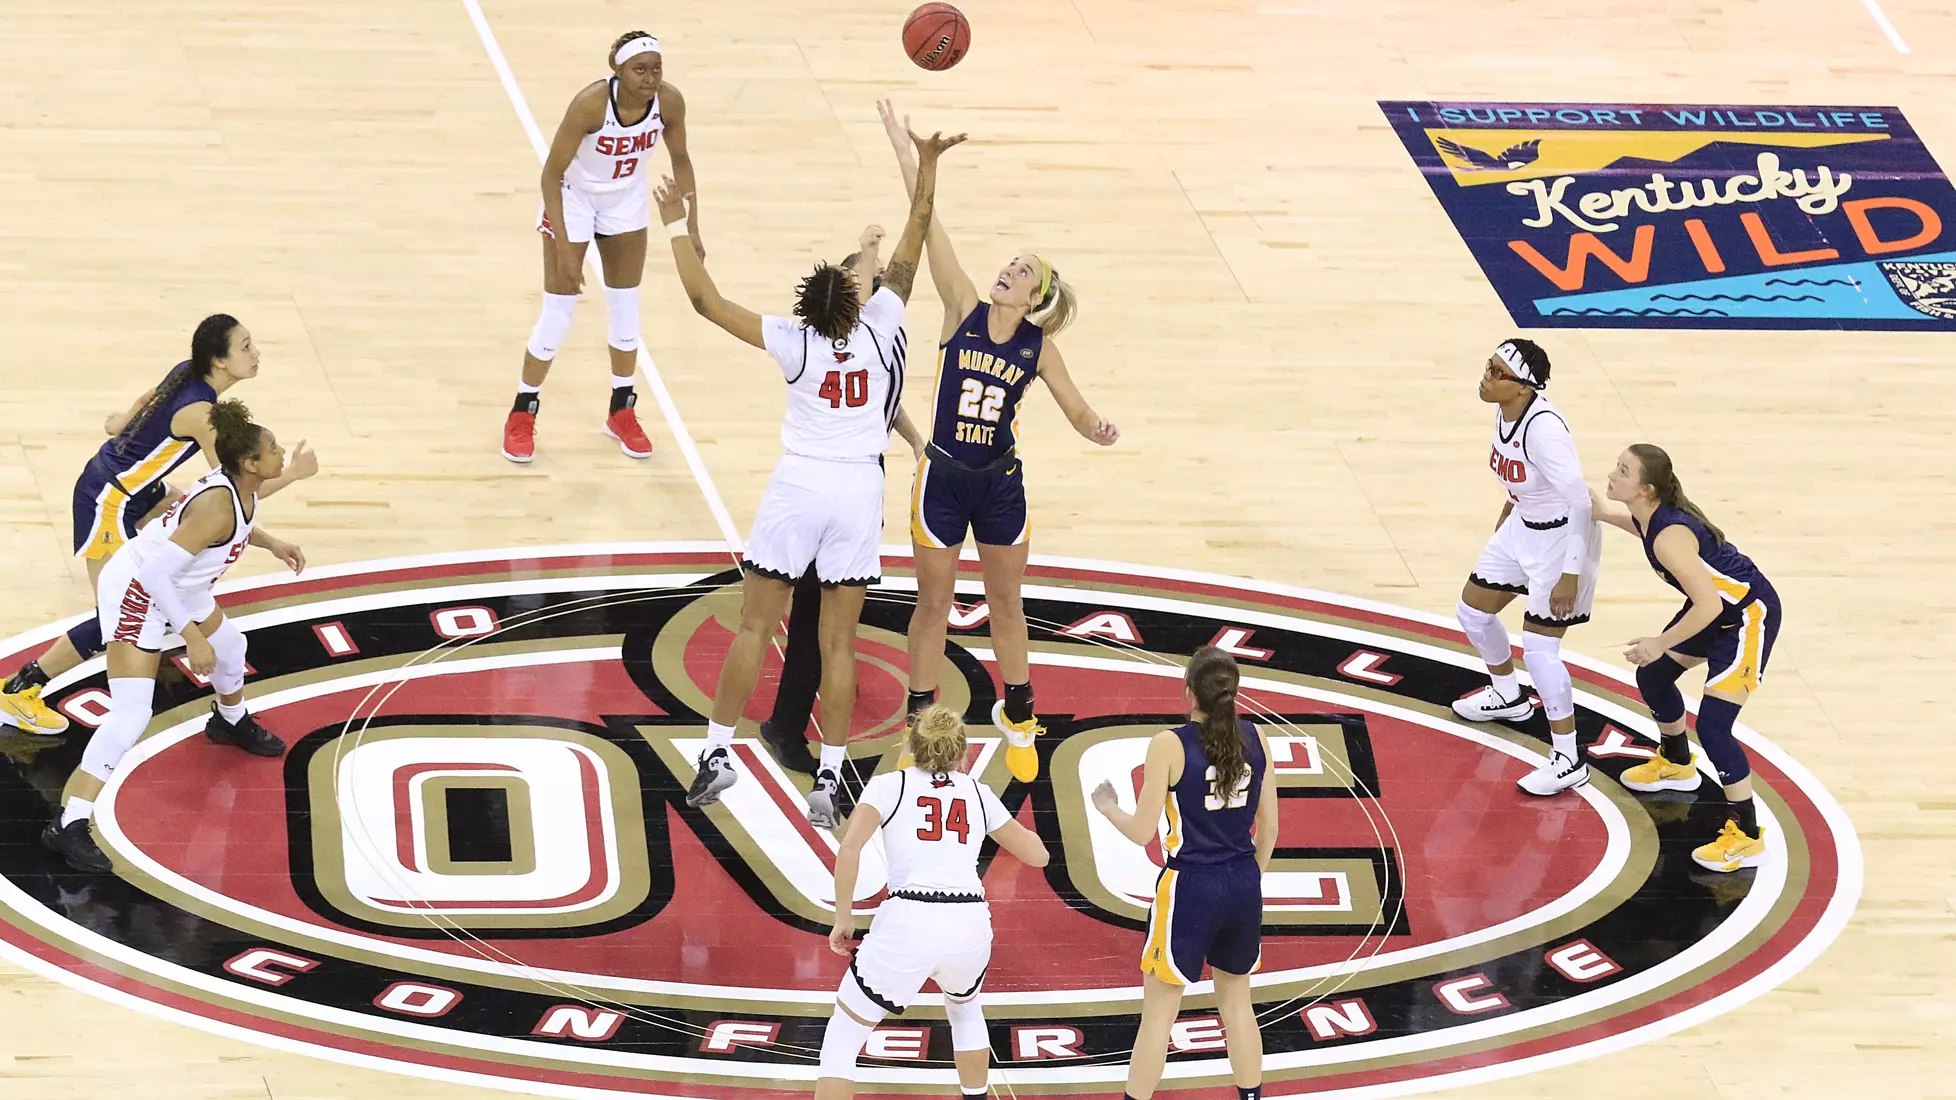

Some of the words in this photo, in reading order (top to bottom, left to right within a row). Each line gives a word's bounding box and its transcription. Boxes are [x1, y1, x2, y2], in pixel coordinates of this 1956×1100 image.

[1406, 107, 1421, 123] I
[1441, 108, 1643, 125] SUPPORT
[1662, 109, 1889, 129] WILDLIFE
[595, 128, 659, 156] SEMO
[612, 157, 639, 180] 13
[1506, 152, 1853, 232] Kentucky
[1507, 196, 1943, 291] WILD
[958, 348, 1025, 387] MURRAY
[818, 368, 869, 409] 40
[957, 376, 1007, 424] 22
[955, 421, 996, 446] STATE
[1489, 444, 1527, 483] EMO
[916, 795, 970, 845] 34
[222, 937, 1624, 1062] CONFERENCE
